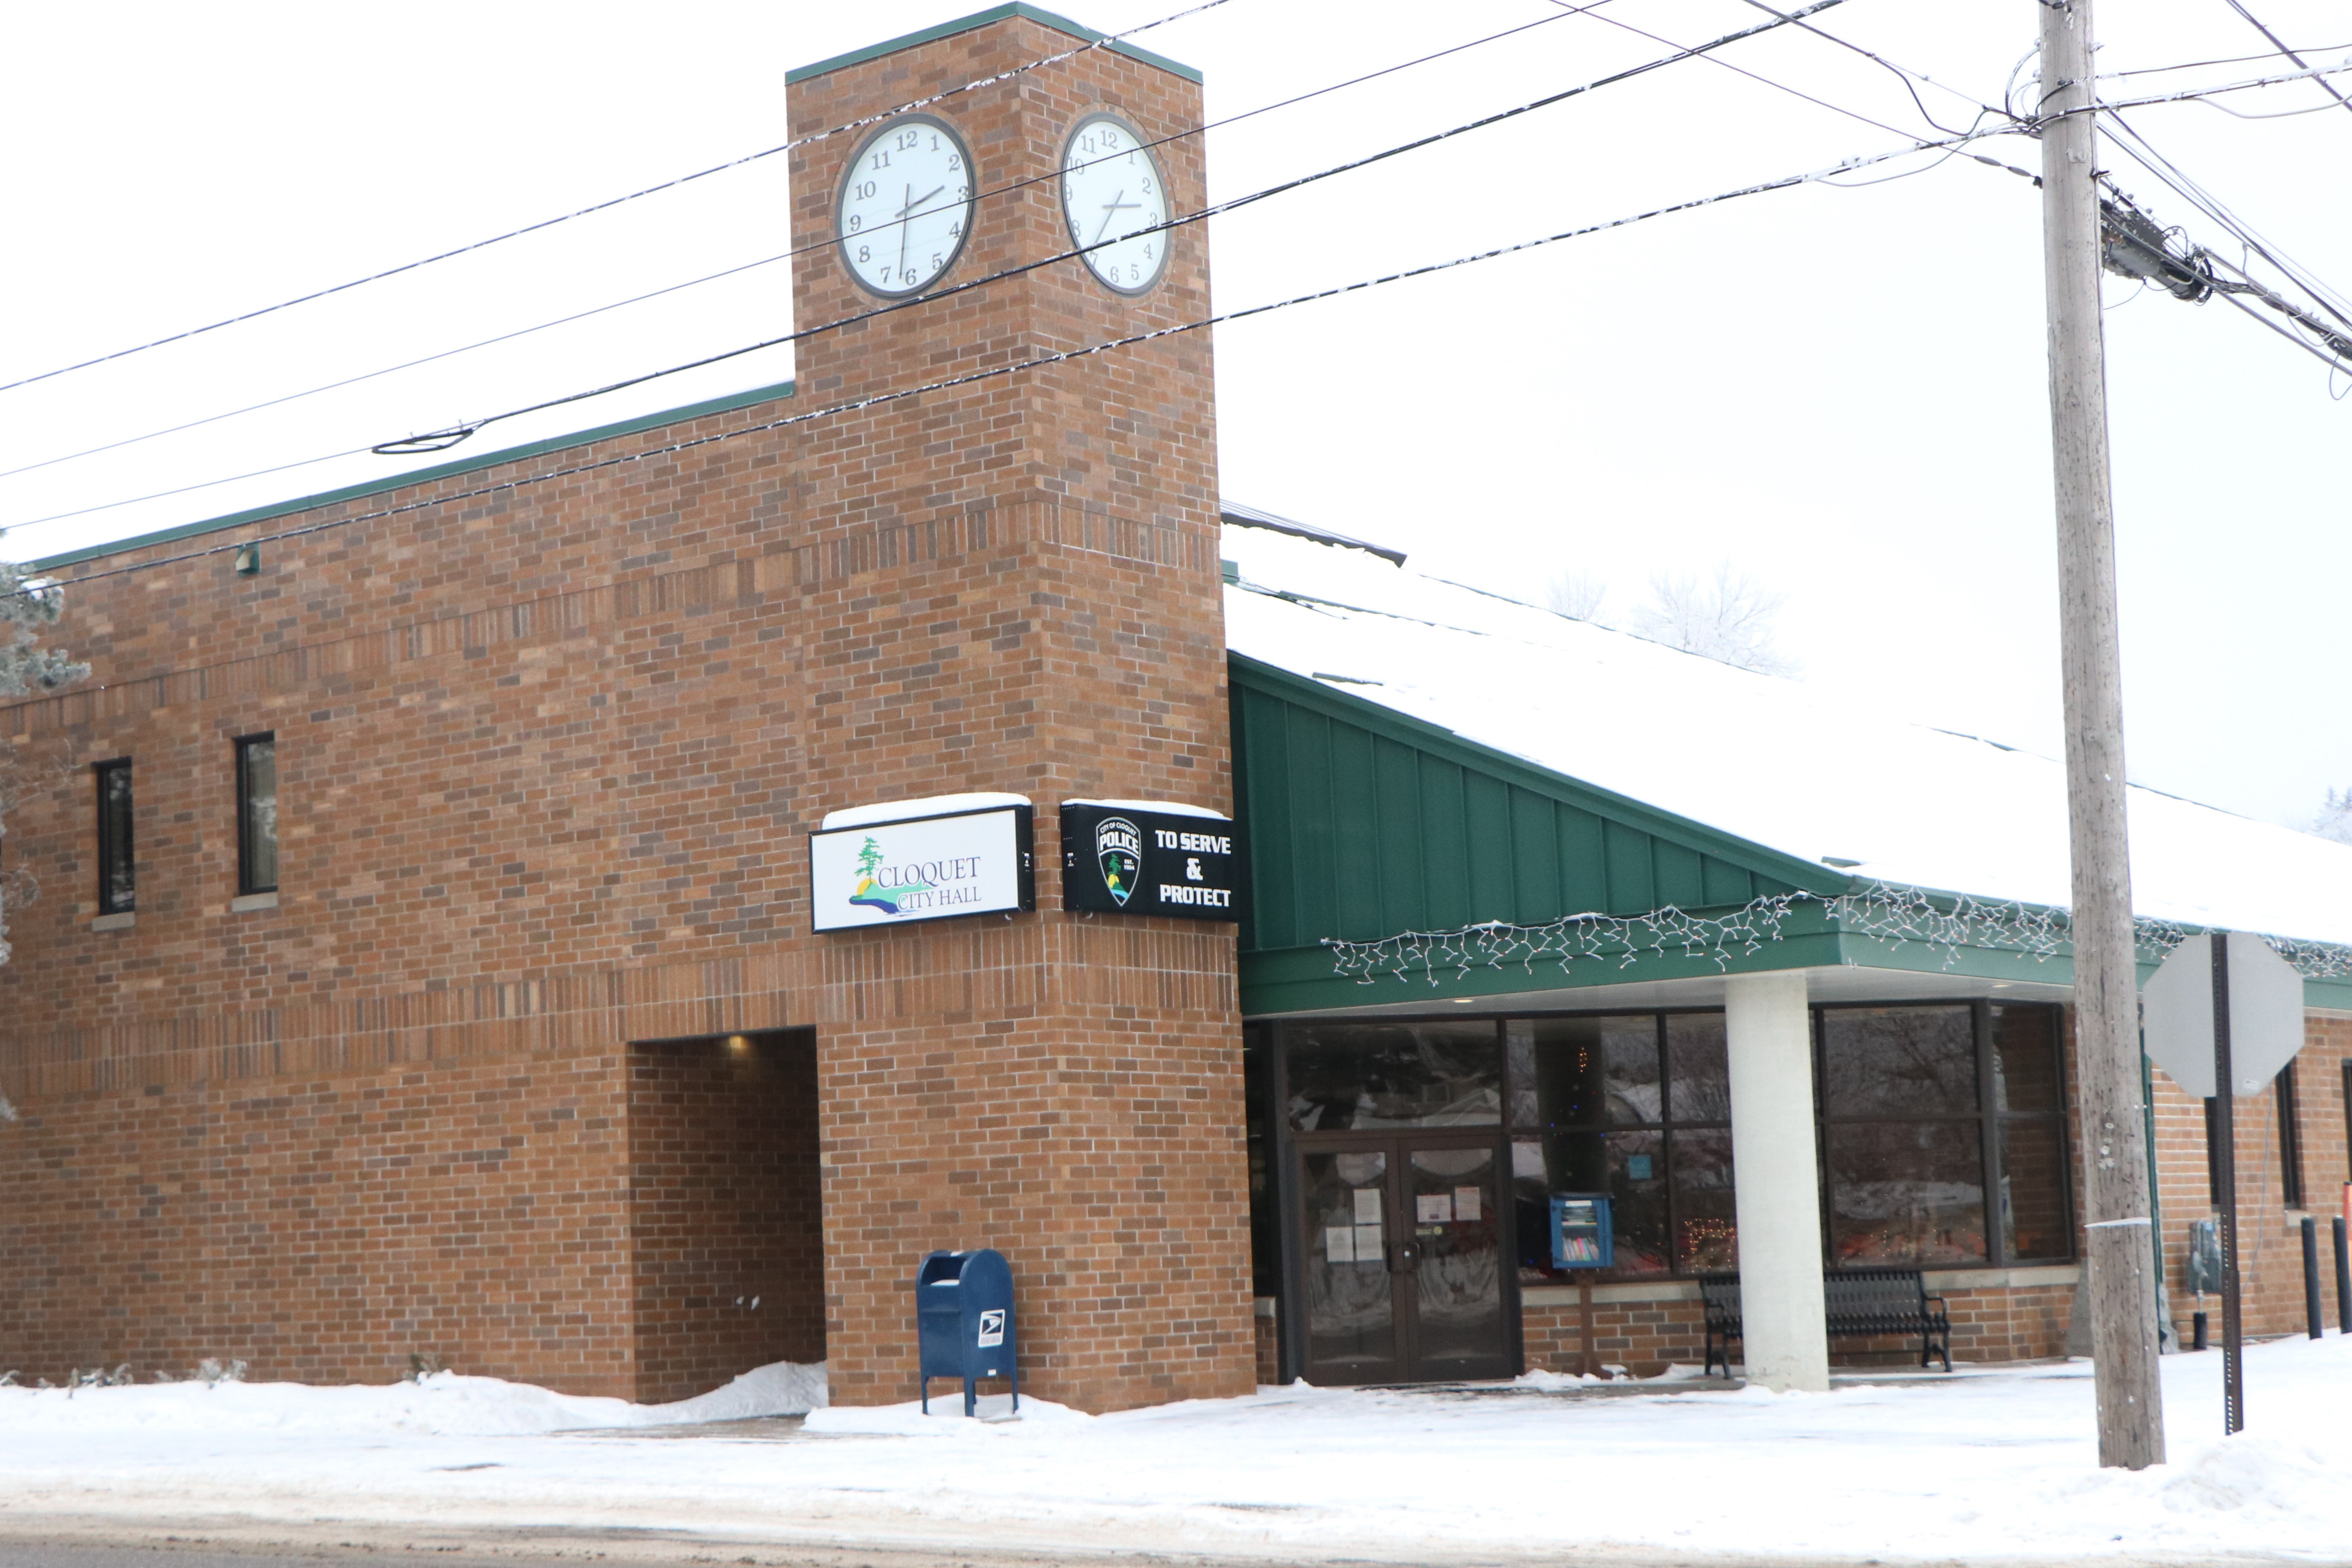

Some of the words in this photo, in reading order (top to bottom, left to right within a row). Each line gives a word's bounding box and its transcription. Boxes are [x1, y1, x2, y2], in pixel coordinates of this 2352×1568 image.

[897, 130, 918, 152] 12
[931, 134, 941, 152] 1
[1081, 134, 1096, 154] 11
[1101, 130, 1118, 149] 12
[872, 151, 891, 170] 11
[949, 154, 960, 172] 2
[1068, 156, 1084, 175] 10
[1128, 148, 1135, 165] 1
[855, 181, 876, 201] 10
[958, 186, 968, 203] 3
[1142, 177, 1151, 195] 2
[850, 214, 861, 231] 9
[1072, 219, 1081, 237] 8
[1150, 212, 1158, 227] 3
[949, 221, 961, 238] 4
[859, 245, 870, 262] 8
[1144, 243, 1153, 260] 4
[932, 252, 942, 270] 5
[881, 266, 891, 284] 7
[905, 268, 916, 285] 6
[1110, 266, 1119, 283] 6
[1131, 263, 1139, 280] 5
[1100, 824, 1109, 833] CITY
[1116, 822, 1136, 836] CLOQUET
[1099, 831, 1139, 855] POLICE
[1155, 829, 1177, 849] TO
[1180, 832, 1231, 854] SERVE
[878, 856, 981, 888] CLOQUET
[1186, 857, 1203, 880] &
[898, 891, 934, 910] CITY
[939, 886, 982, 905] HALL
[1160, 884, 1231, 908] PROTECT
